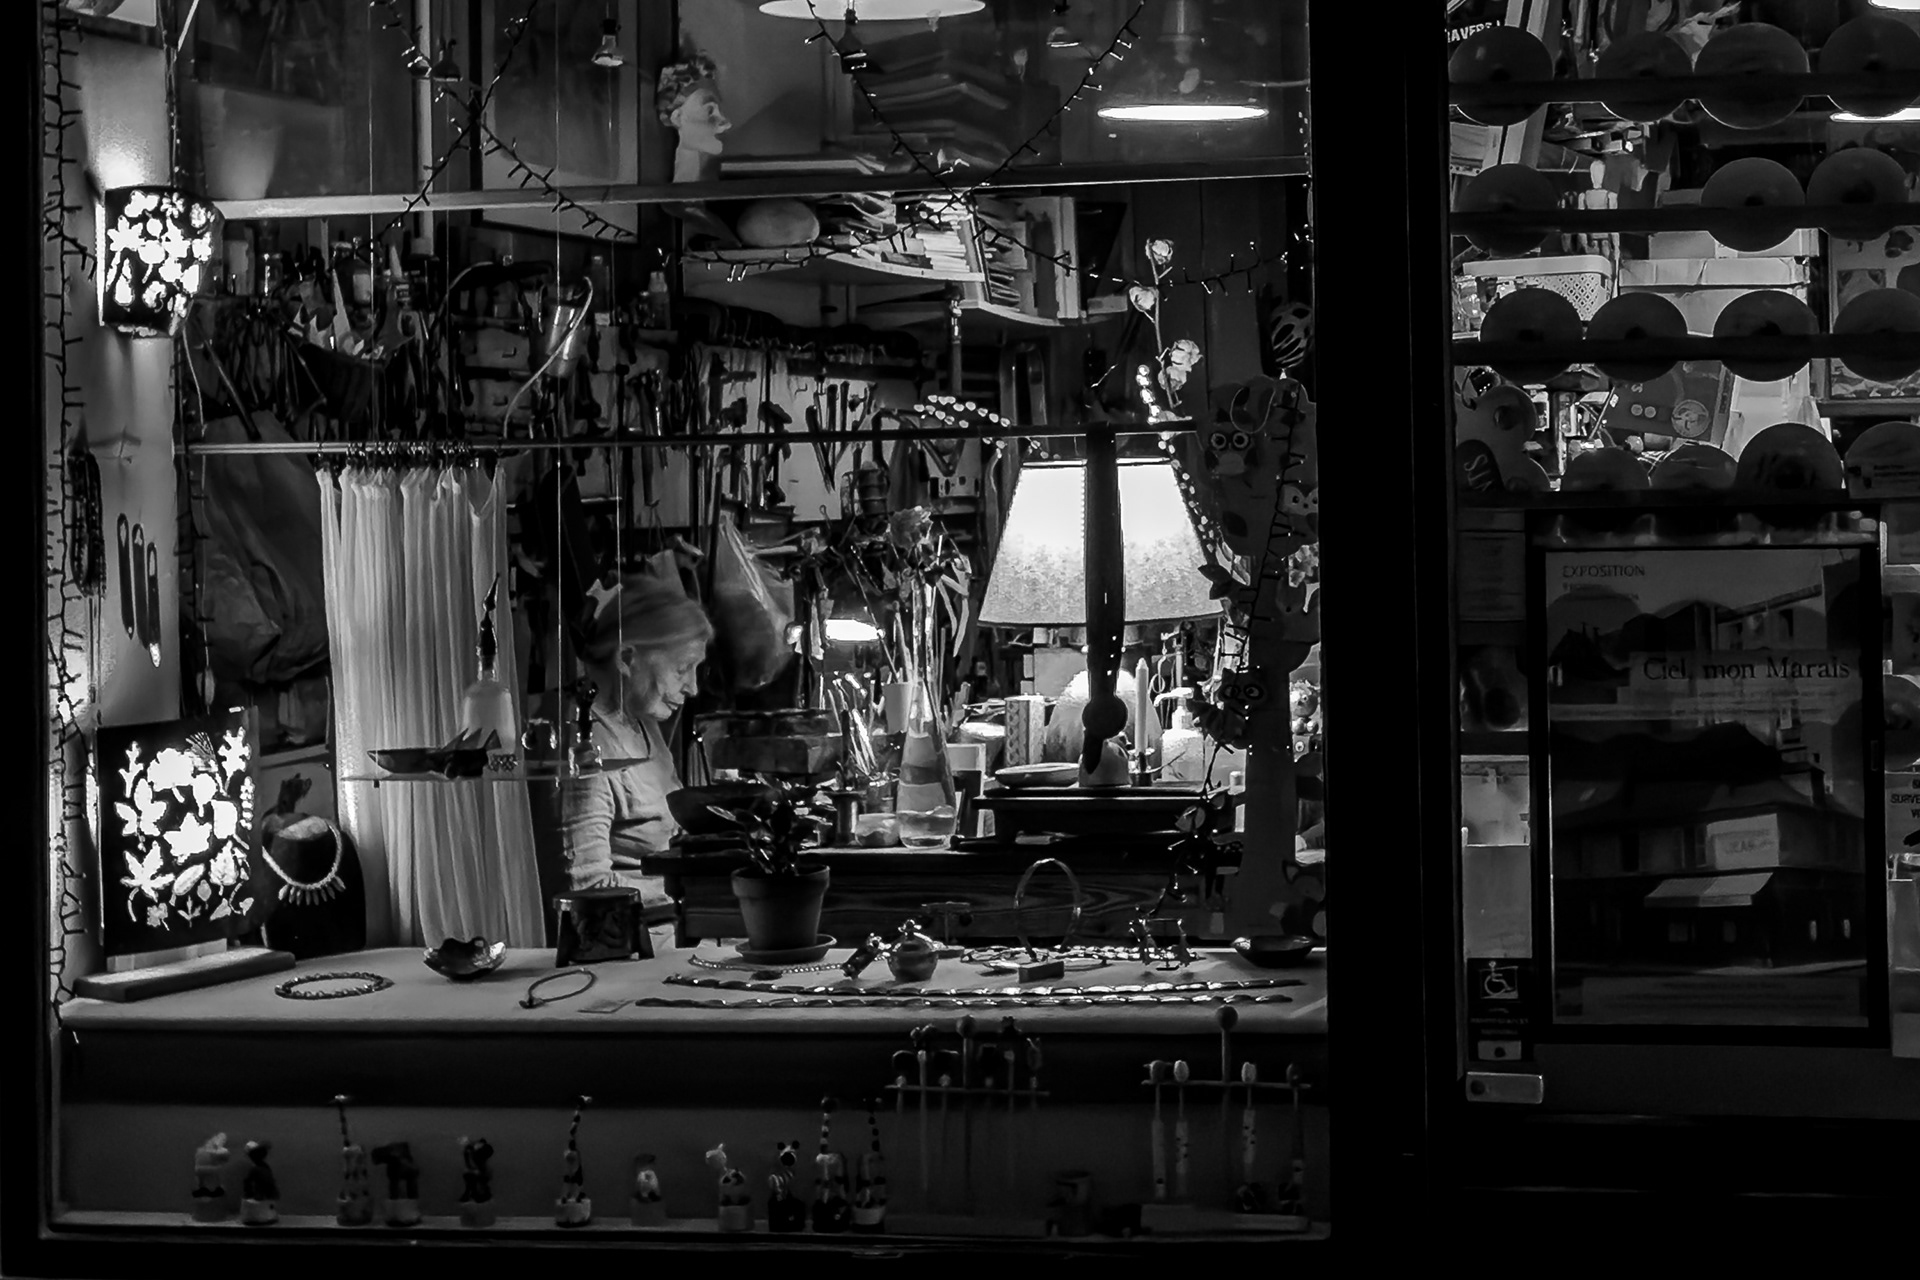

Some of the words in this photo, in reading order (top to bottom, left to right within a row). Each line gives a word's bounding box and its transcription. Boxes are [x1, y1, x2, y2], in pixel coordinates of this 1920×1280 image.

[1562, 565, 1646, 578] EXPOSITION
[1703, 663, 1755, 679] mon
[1766, 656, 1850, 679] Marais
